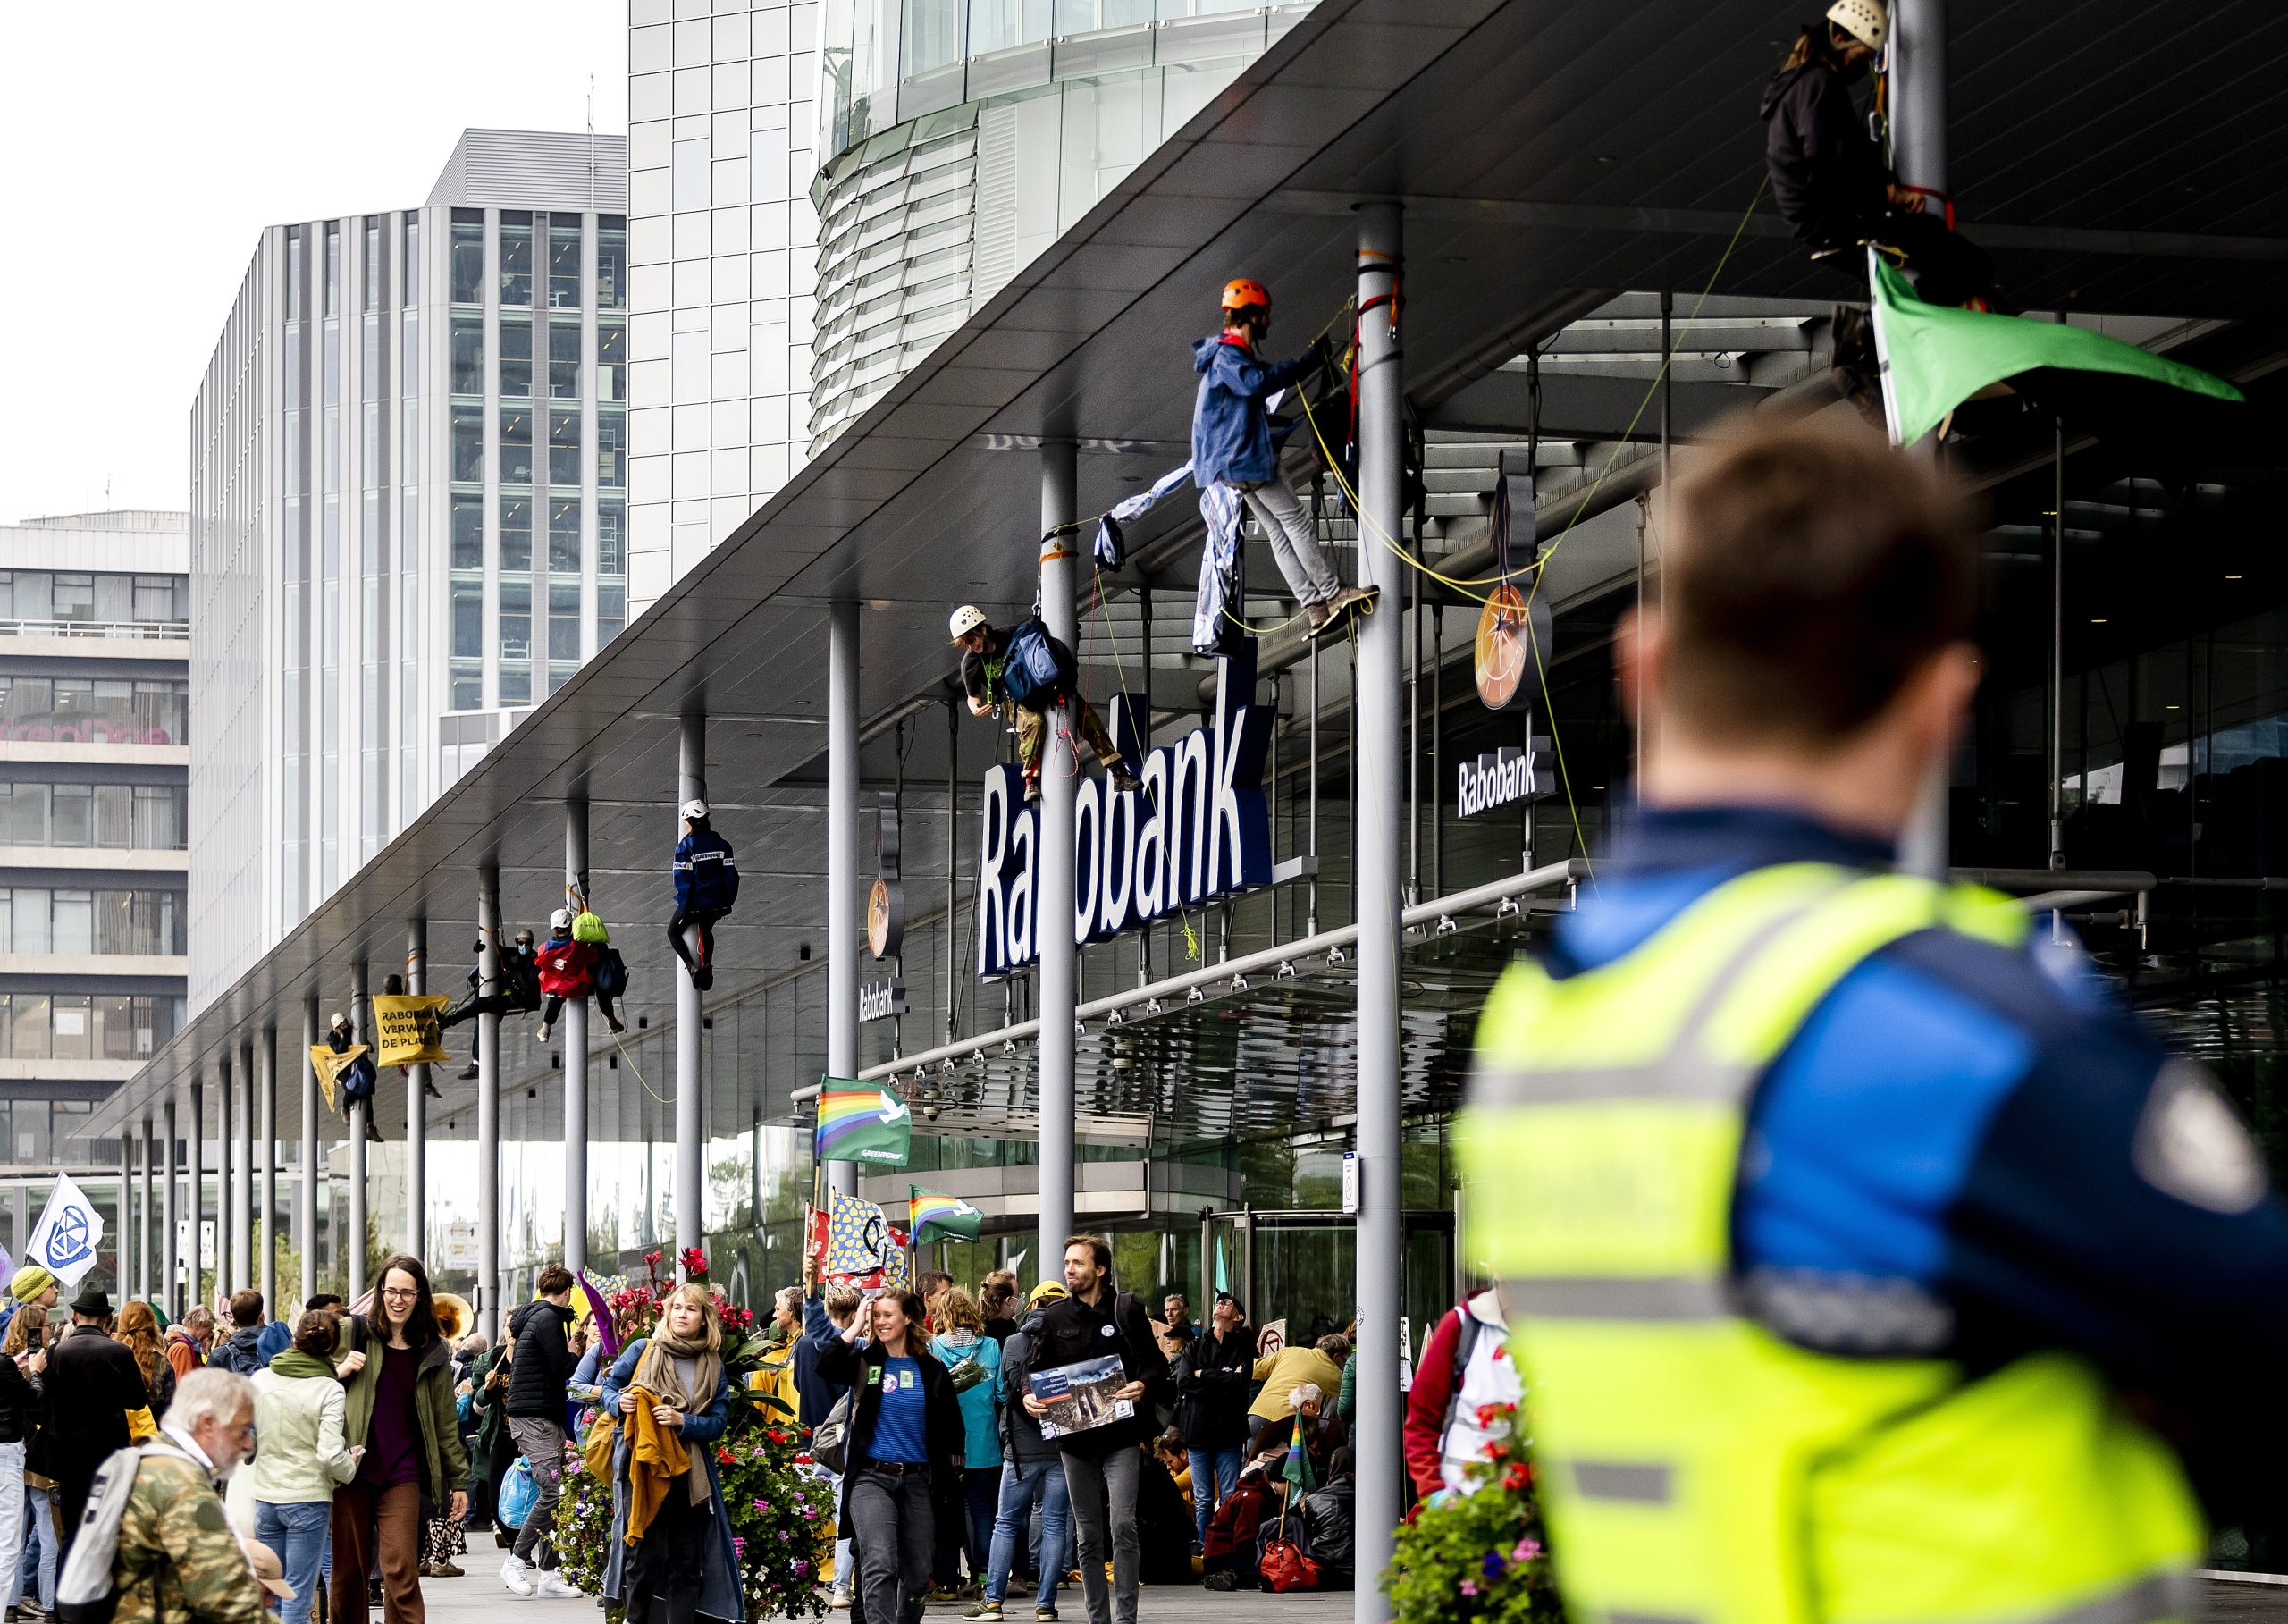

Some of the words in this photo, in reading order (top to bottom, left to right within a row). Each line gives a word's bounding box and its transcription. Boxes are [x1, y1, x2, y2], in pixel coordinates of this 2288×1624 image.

[1458, 736, 1535, 818] Rabobank
[980, 657, 1247, 976] Raobank
[859, 977, 893, 1022] Rabobank
[382, 1039, 398, 1048] DE
